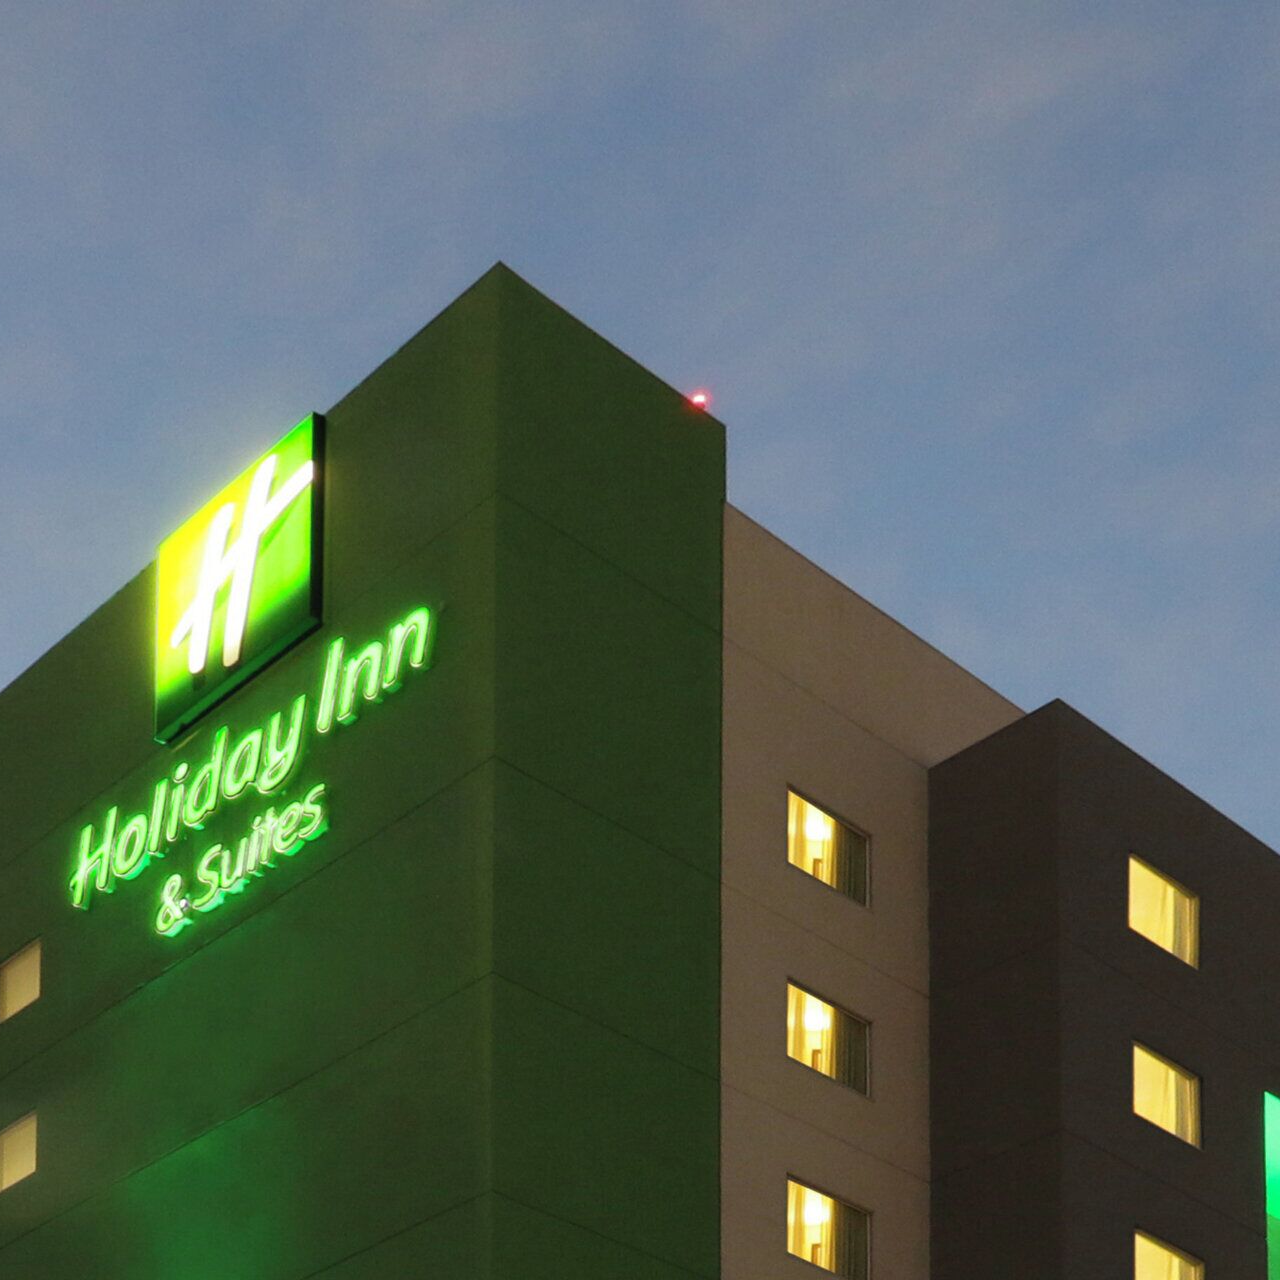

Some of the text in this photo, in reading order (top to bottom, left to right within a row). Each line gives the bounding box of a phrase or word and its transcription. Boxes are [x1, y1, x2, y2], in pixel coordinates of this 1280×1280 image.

[69, 606, 431, 909] Holiday Inn
[155, 783, 327, 936] & Suites
